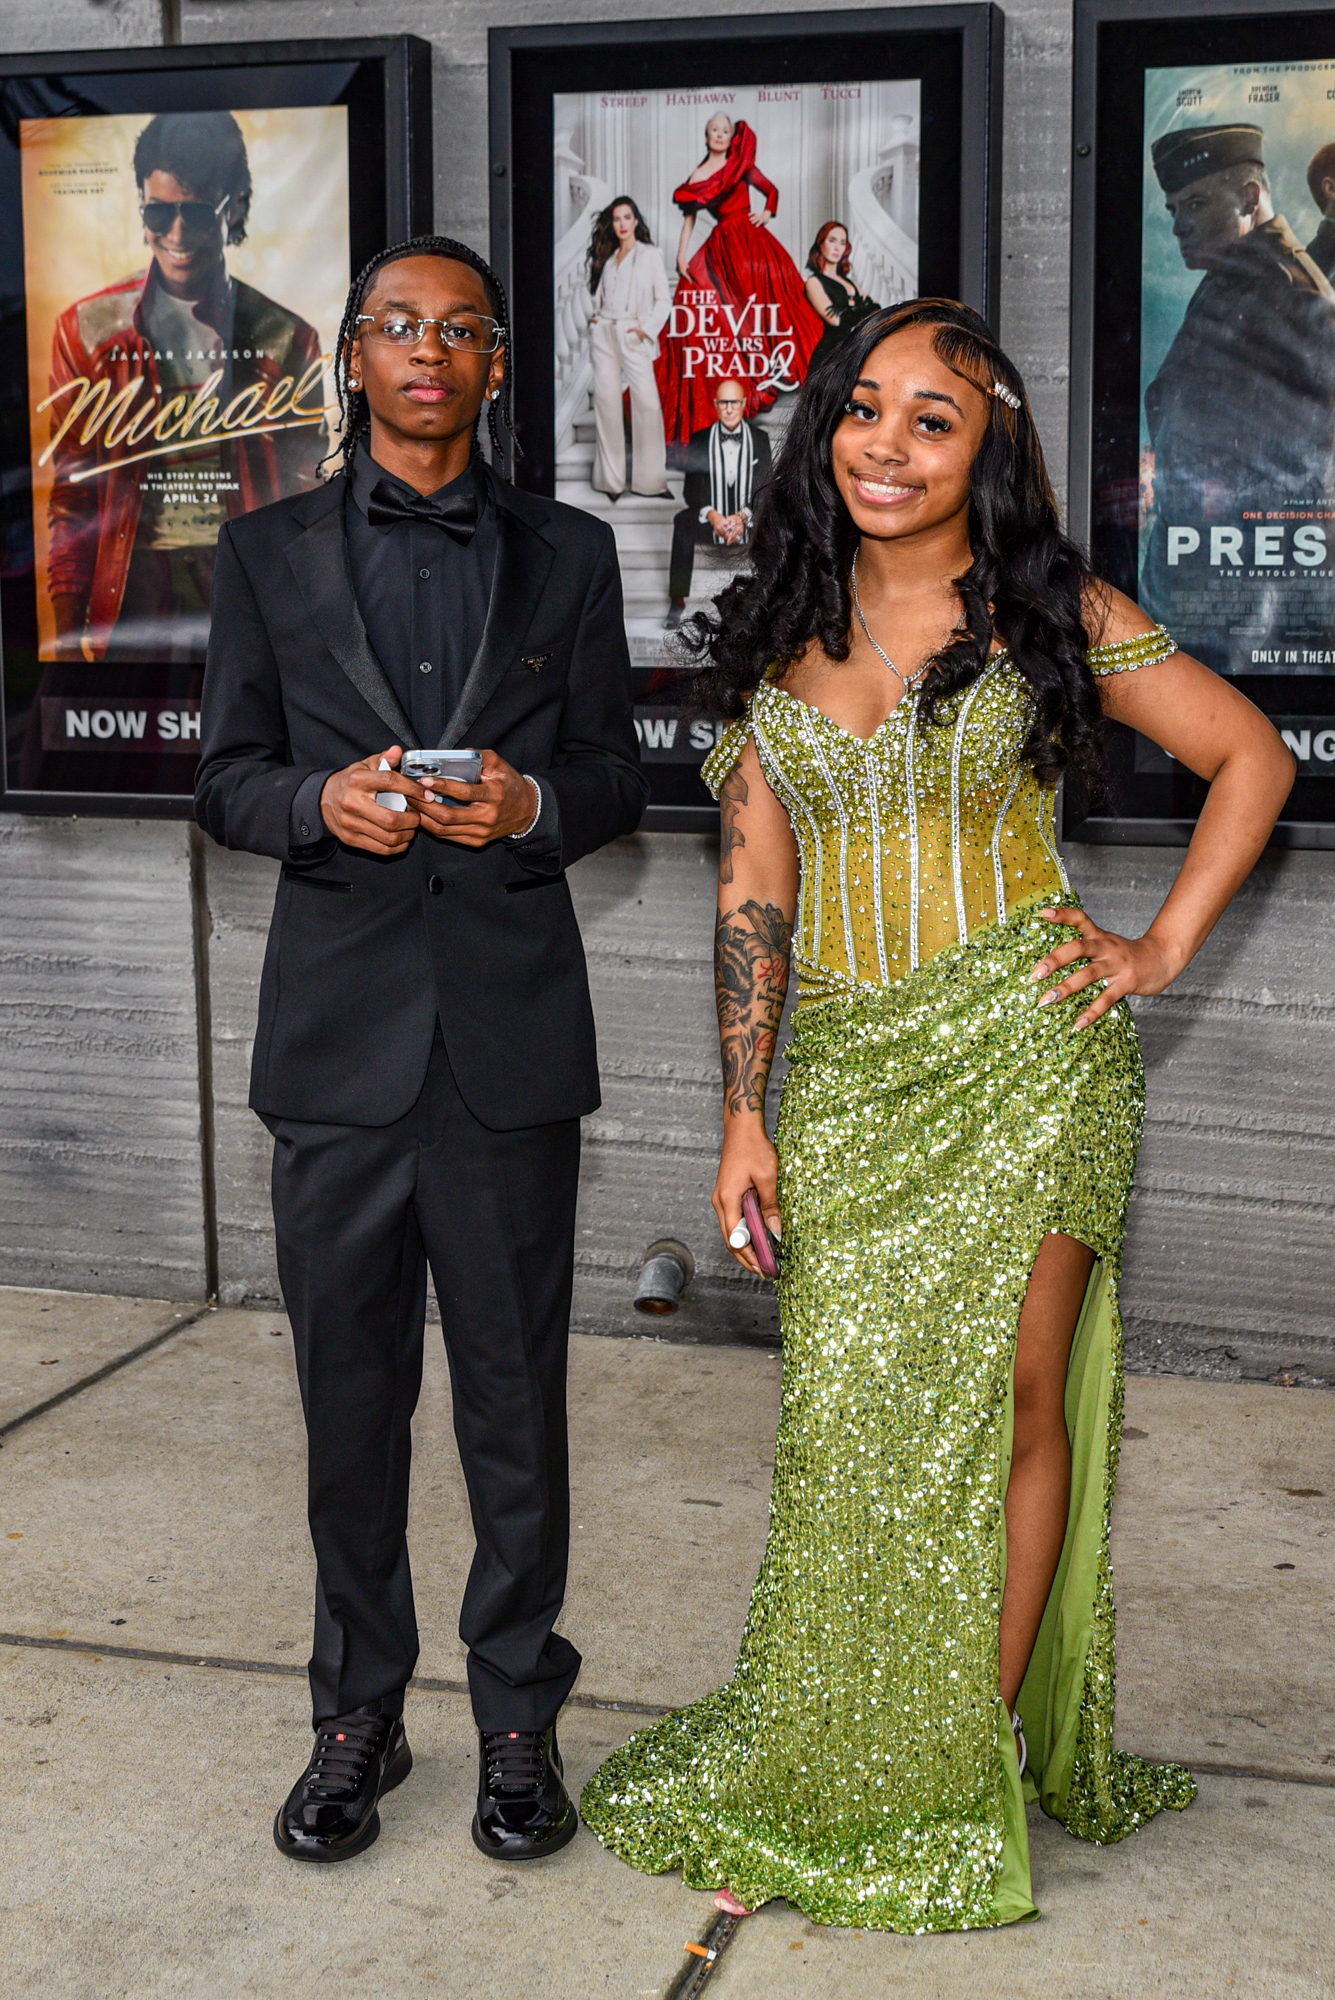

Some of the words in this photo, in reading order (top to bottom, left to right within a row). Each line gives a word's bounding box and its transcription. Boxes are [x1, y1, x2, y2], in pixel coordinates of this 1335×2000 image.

[666, 93, 736, 106] HATHAWAY
[758, 90, 800, 102] BLUNT
[821, 87, 862, 100] TUCCI
[1248, 92, 1280, 103] FRASER
[601, 96, 648, 108] STREEP
[1176, 95, 1203, 107] SCOTT
[679, 289, 717, 305] THE
[667, 292, 793, 338] DEVIL
[703, 337, 764, 352] WEARS
[110, 350, 174, 361] JAAFAR
[186, 349, 265, 360] JACKSON
[682, 346, 792, 378] PRADA
[36, 353, 340, 467] Michael
[147, 471, 163, 480] HIS
[166, 471, 195, 480] STORY
[198, 471, 231, 480] BEGINS
[139, 483, 149, 491] IN
[151, 482, 194, 491] THEATERS
[196, 482, 213, 491] AND
[215, 482, 240, 491] IMAX
[163, 493, 199, 504] APRIL
[203, 493, 218, 503] 24
[1242, 511, 1263, 520] ONE
[1266, 511, 1314, 520] DECISION
[1167, 525, 1327, 567] PRES
[1303, 569, 1334, 577] TRUE
[1252, 650, 1280, 664] ONLY
[1285, 650, 1297, 663] IN
[65, 709, 148, 739] NOW
[157, 710, 201, 740] SH
